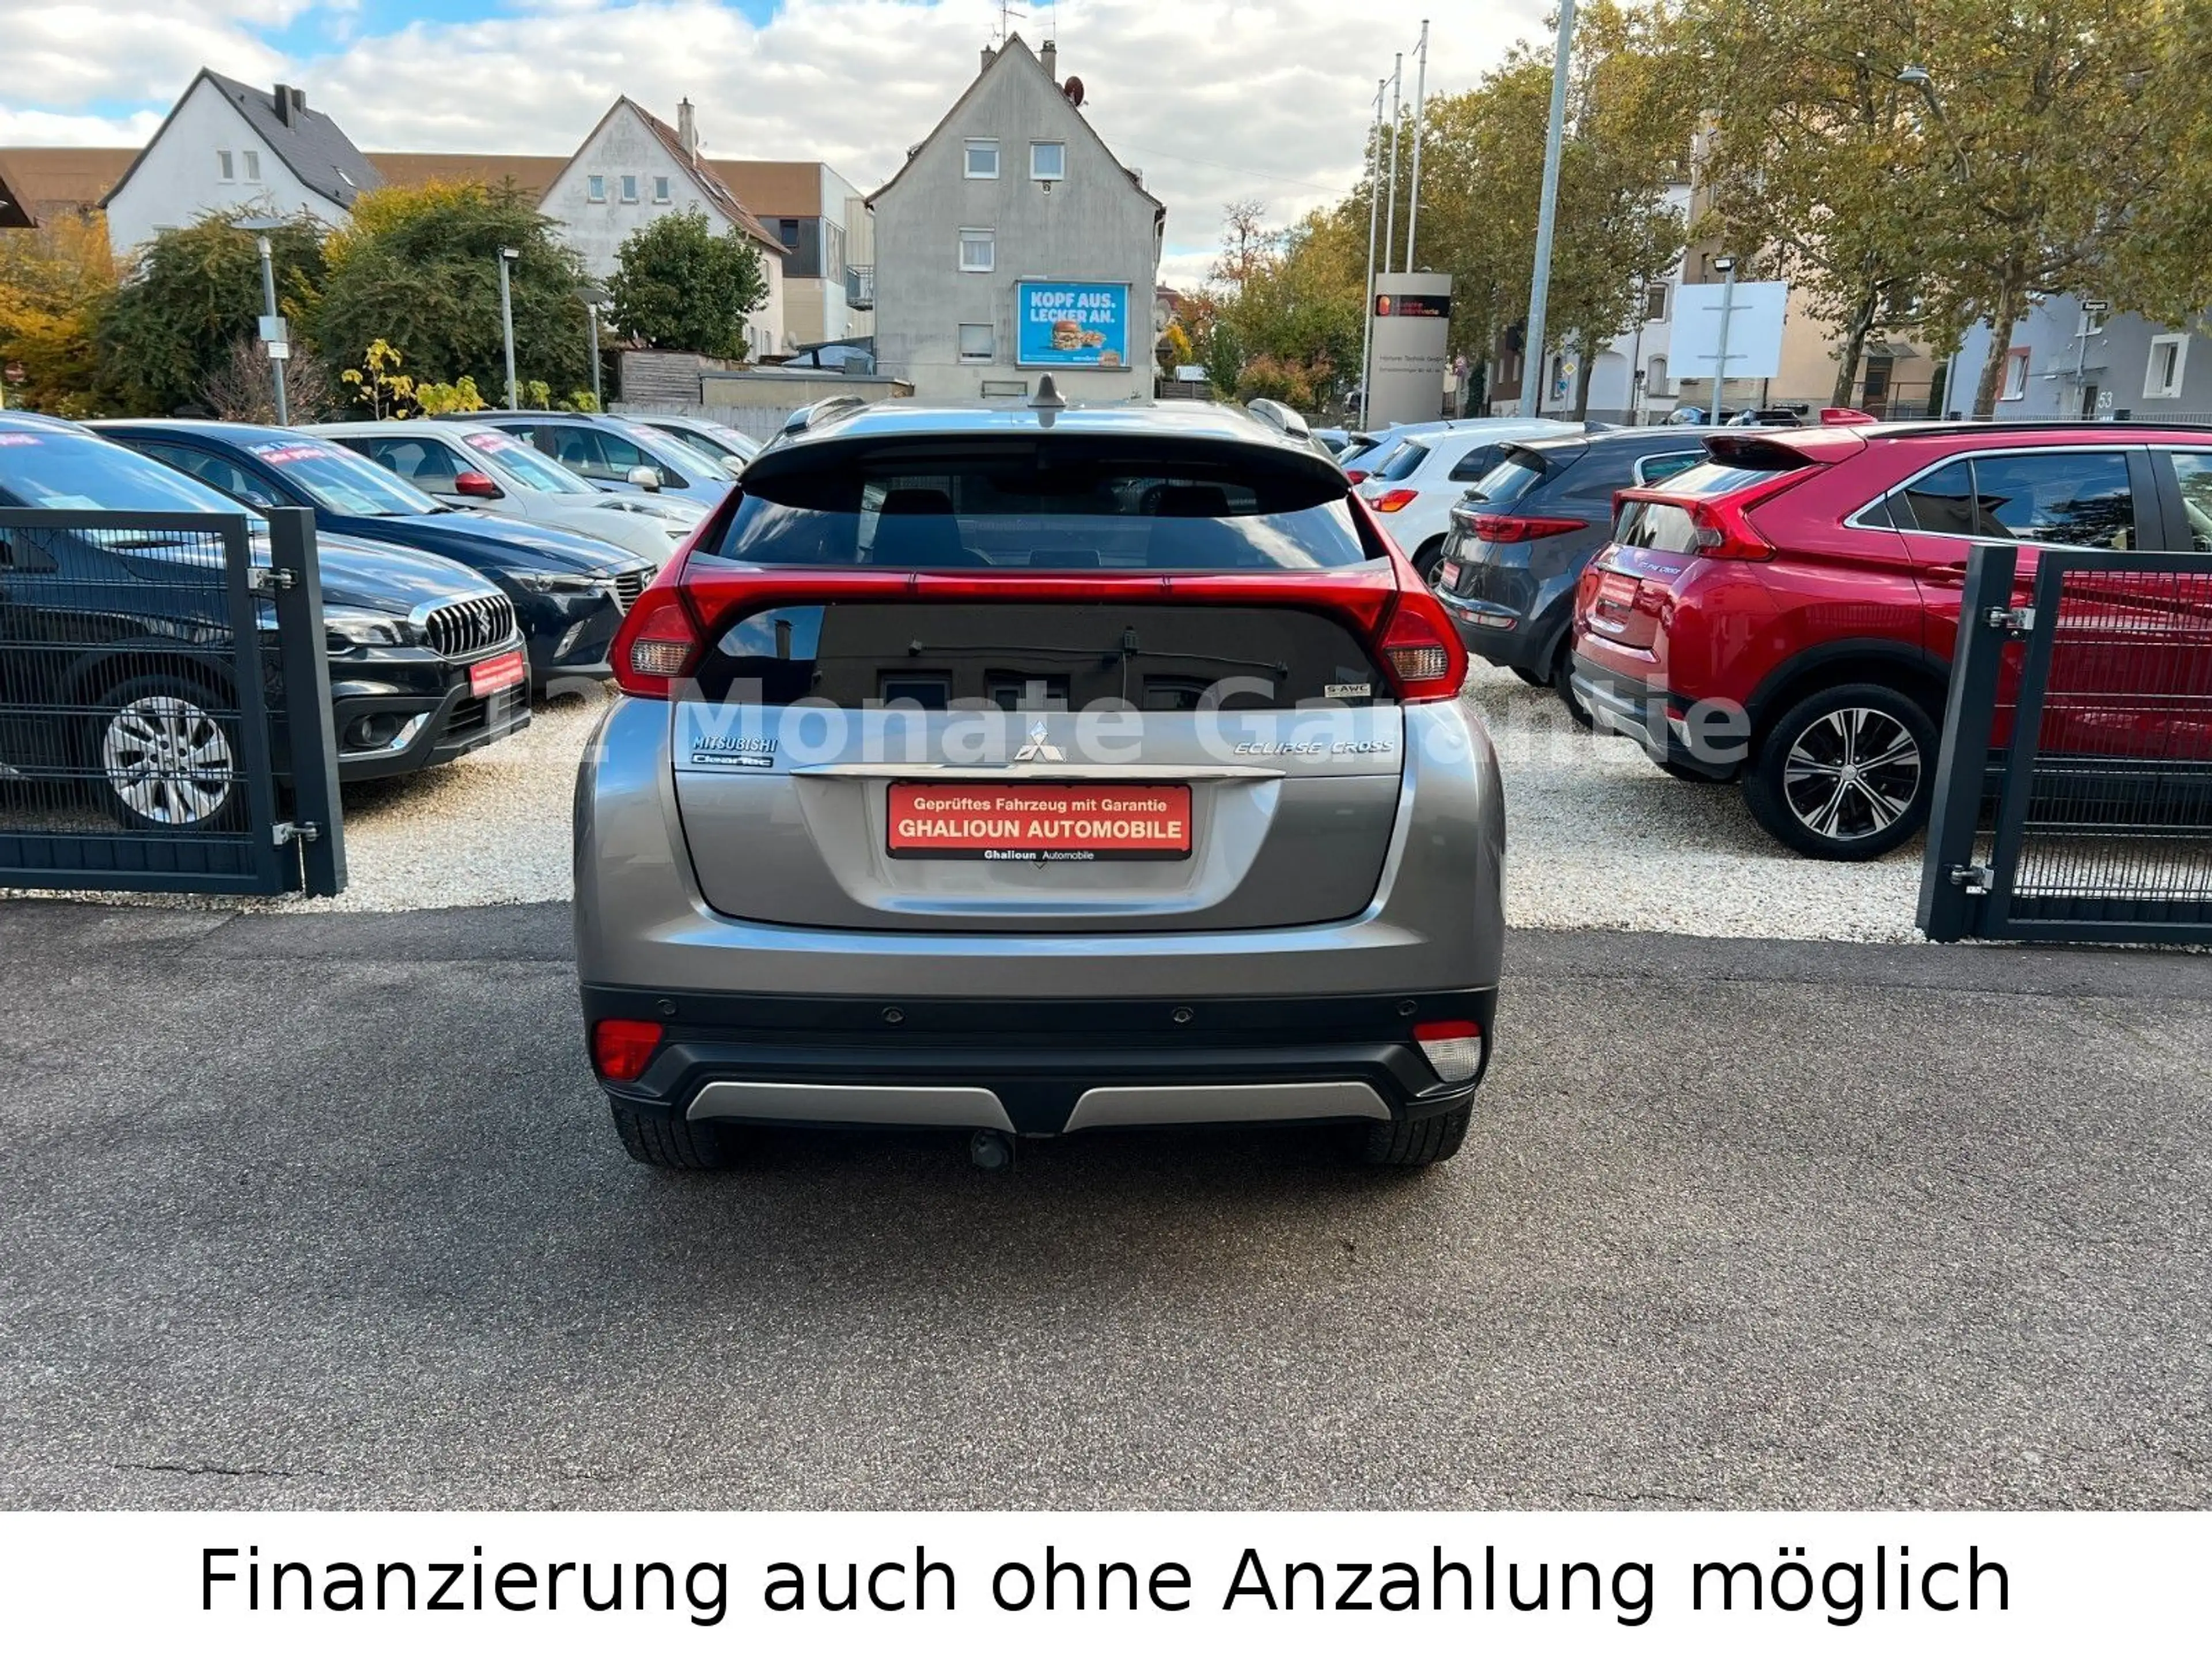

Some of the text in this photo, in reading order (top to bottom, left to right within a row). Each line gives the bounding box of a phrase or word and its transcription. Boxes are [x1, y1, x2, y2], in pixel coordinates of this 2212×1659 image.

[1031, 291, 1116, 309] KOPF AUS.
[1030, 308, 1116, 323] LECKER AN.
[2098, 391, 2113, 408] 53
[1327, 684, 1369, 693] S-AWC
[693, 736, 778, 753] MITSUBISHI
[1233, 740, 1395, 755] ECLIPSE CROSS
[914, 797, 1167, 813] Geprüftes Fahrzeug mit Garantie
[898, 819, 1182, 839] GHALIOUN AUTOMOBILE
[984, 850, 1094, 860] Ghalioun Automobile
